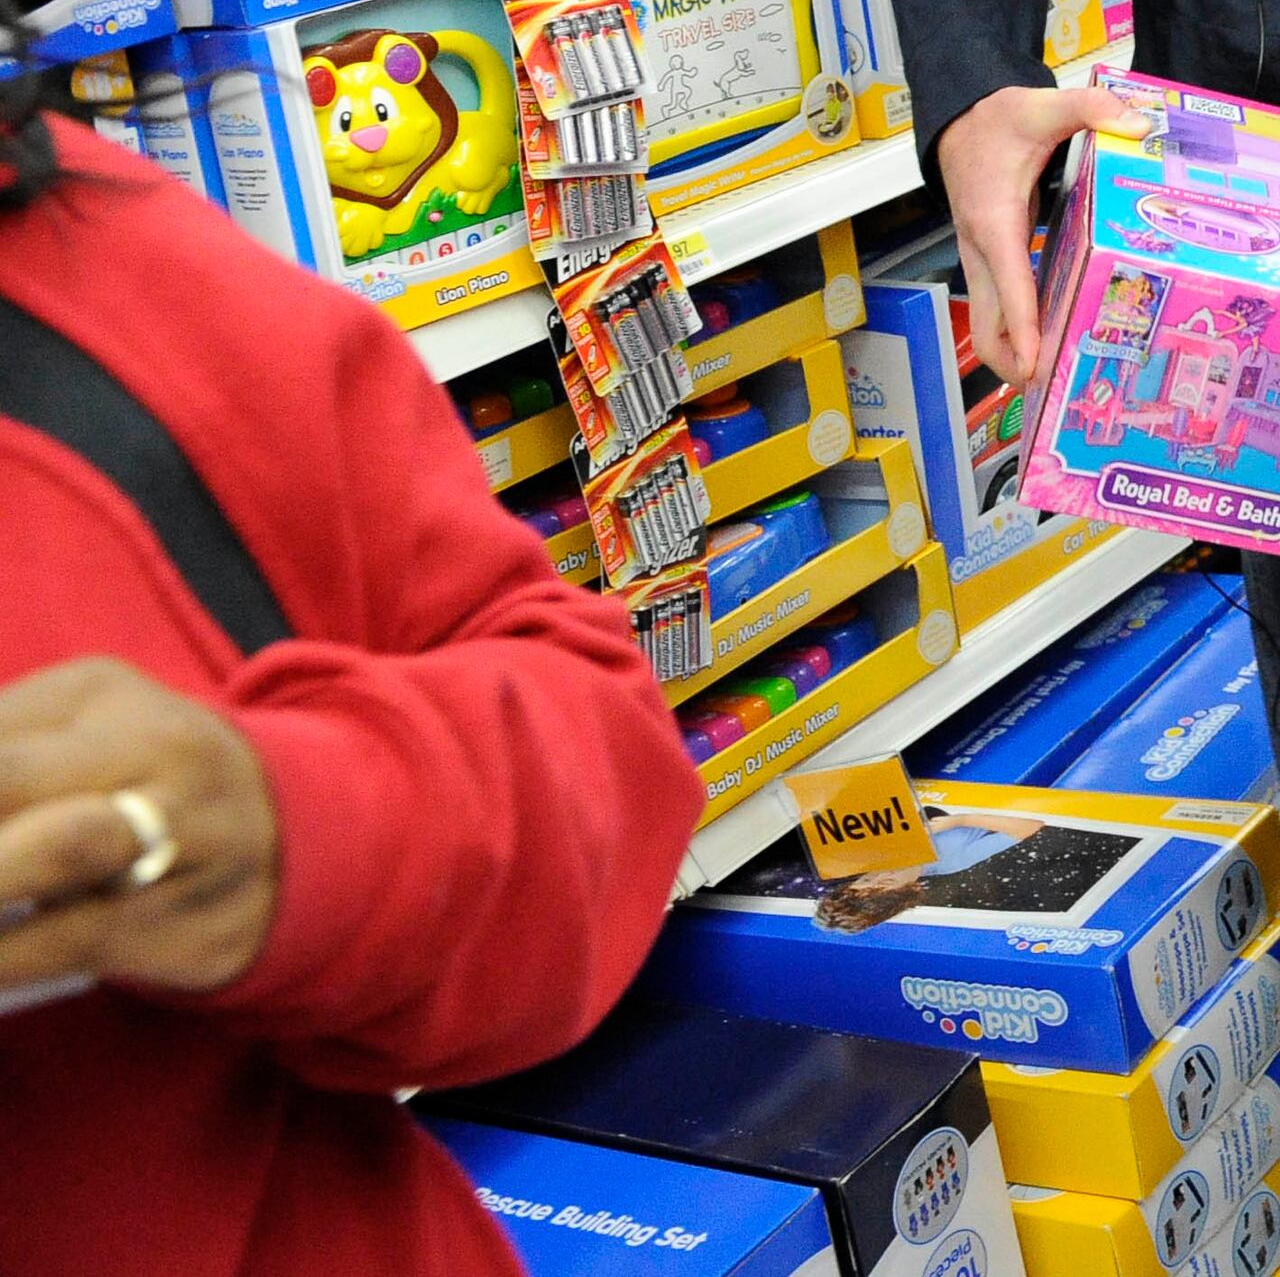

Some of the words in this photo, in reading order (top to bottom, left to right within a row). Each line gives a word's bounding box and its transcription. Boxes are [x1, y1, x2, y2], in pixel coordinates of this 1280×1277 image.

[117, 6, 147, 27] Kid
[658, 17, 721, 51] TRAVEL
[722, 8, 757, 32] SIZE
[436, 288, 465, 306] Lion
[469, 271, 509, 294] Piano
[693, 353, 732, 380] Mixer
[1084, 341, 1111, 356] DVD
[1113, 347, 1140, 361] 2012
[1111, 474, 1171, 512] Royal
[1173, 485, 1215, 514] Bed
[1216, 491, 1236, 517] &
[951, 524, 1035, 582] Connection
[965, 529, 993, 553] Kid
[1063, 531, 1085, 554] Car
[717, 635, 735, 658] DJ
[737, 614, 775, 645] Music
[775, 589, 811, 621] Mixer
[706, 766, 743, 801] Baby
[745, 753, 763, 777] DJ
[766, 727, 804, 762] Music
[804, 702, 841, 736] Mixer
[1142, 735, 1172, 766] Kid
[1146, 703, 1241, 782] Connection
[813, 796, 911, 846] New!
[1008, 924, 1124, 947] Connection
[1050, 938, 1084, 955] Kid
[901, 977, 1067, 1026] Connection
[985, 1011, 1037, 1042] Kid
[474, 1185, 553, 1221] Rescue
[551, 1206, 654, 1248] Building
[654, 1225, 707, 1253] Set
